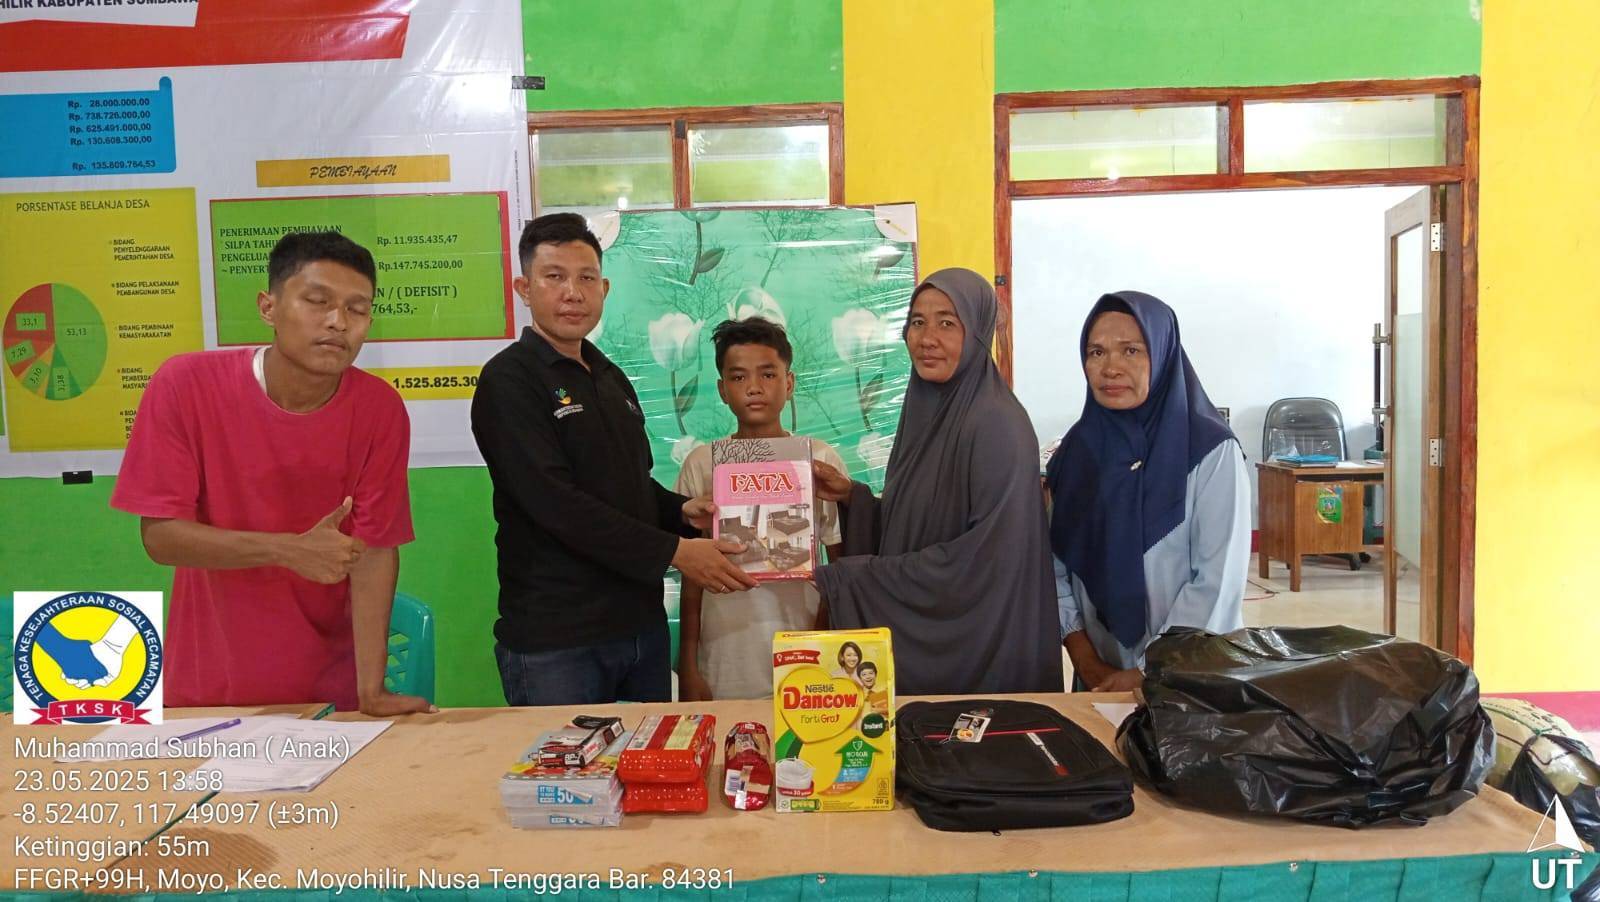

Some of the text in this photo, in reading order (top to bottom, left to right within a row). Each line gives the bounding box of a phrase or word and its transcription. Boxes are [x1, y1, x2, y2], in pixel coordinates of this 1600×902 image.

[67, 100, 82, 109] Rp.
[68, 112, 83, 122] Rp.
[69, 125, 84, 134] Rp.
[70, 137, 85, 146] Rp.
[72, 162, 86, 171] Rp.
[310, 164, 397, 179] PEMBIAYAAN
[16, 198, 150, 212] PORSENTASE BELANJA DESA
[220, 227, 279, 237] PENERIMAAN
[225, 240, 251, 249] SILPA
[377, 234, 458, 246] Rp. 11.935.435,47
[221, 253, 269, 262] PENGELUA
[378, 260, 463, 272] Rp.147.745.200,00
[404, 285, 450, 297] DEFISIT
[371, 302, 418, 314] 764,53,-
[23, 318, 38, 326] 33,1
[393, 376, 478, 389] 1.525.825.30
[730, 472, 794, 494] FATA
[783, 686, 858, 710] Dancow
